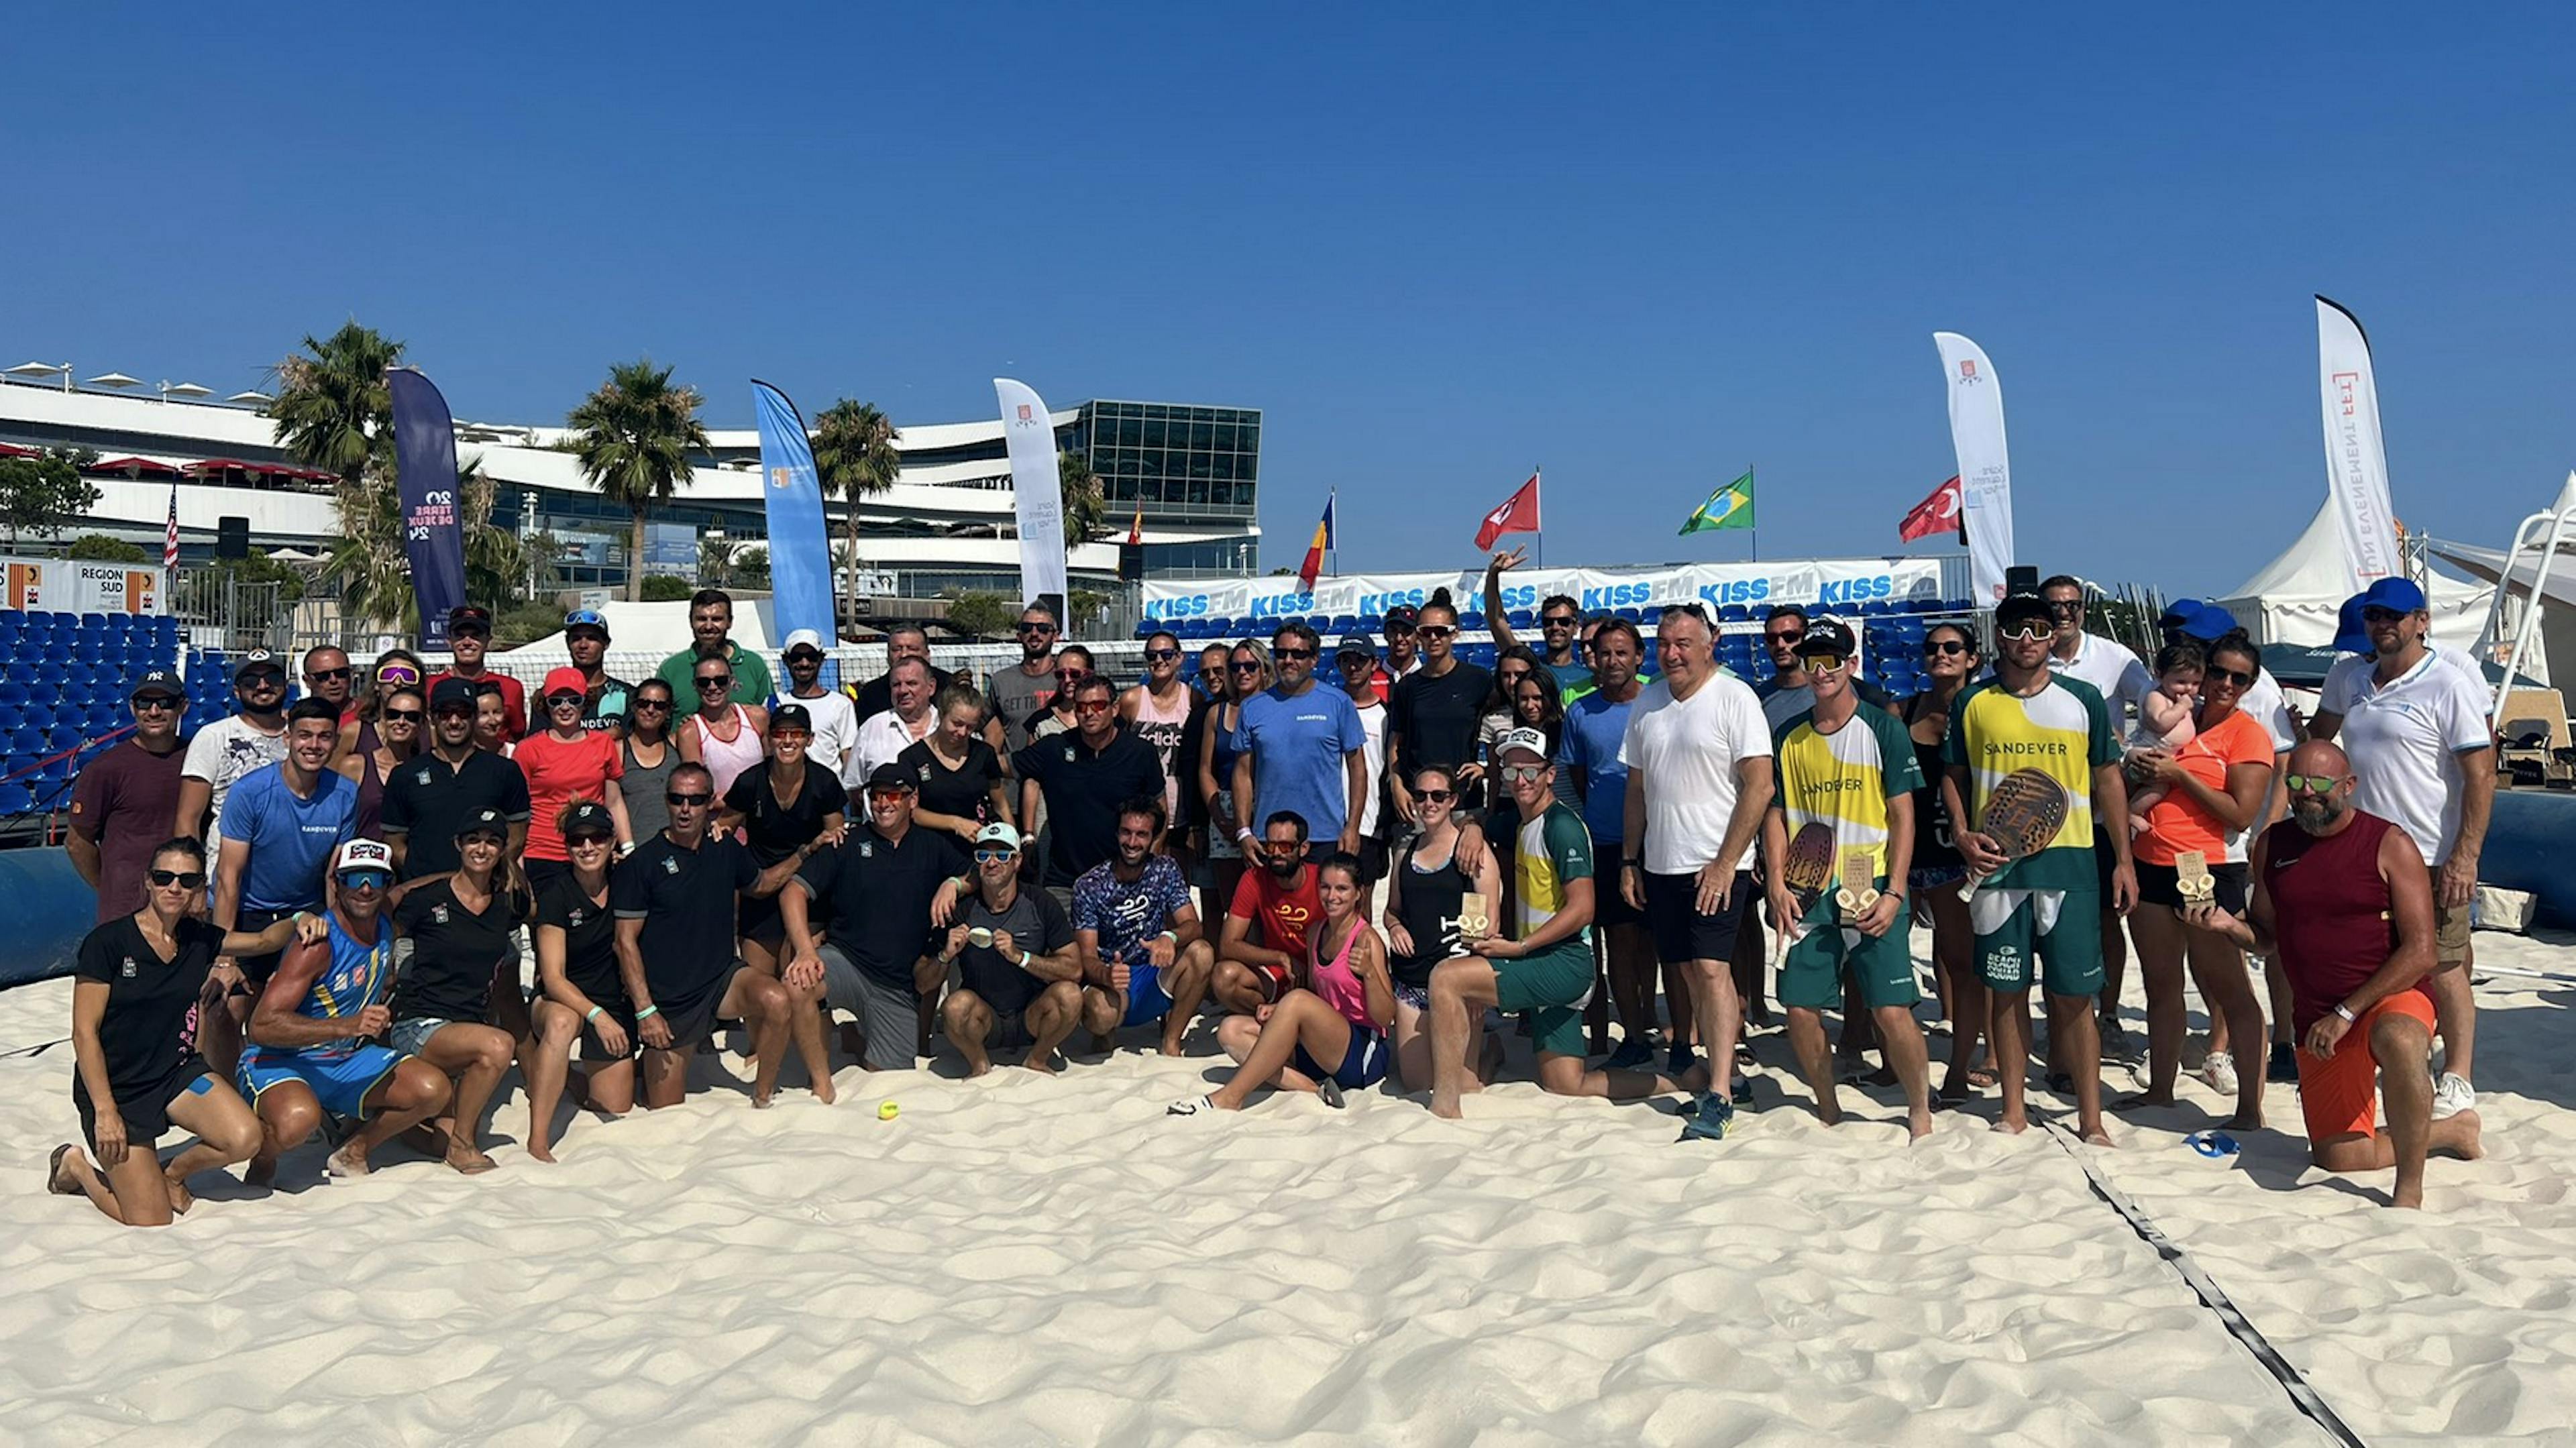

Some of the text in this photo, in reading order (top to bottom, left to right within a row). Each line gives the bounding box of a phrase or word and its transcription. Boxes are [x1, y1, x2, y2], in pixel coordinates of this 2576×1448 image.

[82, 568, 123, 580] REGION
[101, 582, 123, 592] SUD
[1468, 585, 1536, 612] KSS
[1582, 581, 1650, 609] KISS
[1699, 577, 1769, 604] KISS
[1819, 574, 1891, 604] KISS
[1146, 594, 1208, 618] KISS
[1250, 592, 1313, 618] KISS
[1984, 742, 2067, 755] SANDEVER
